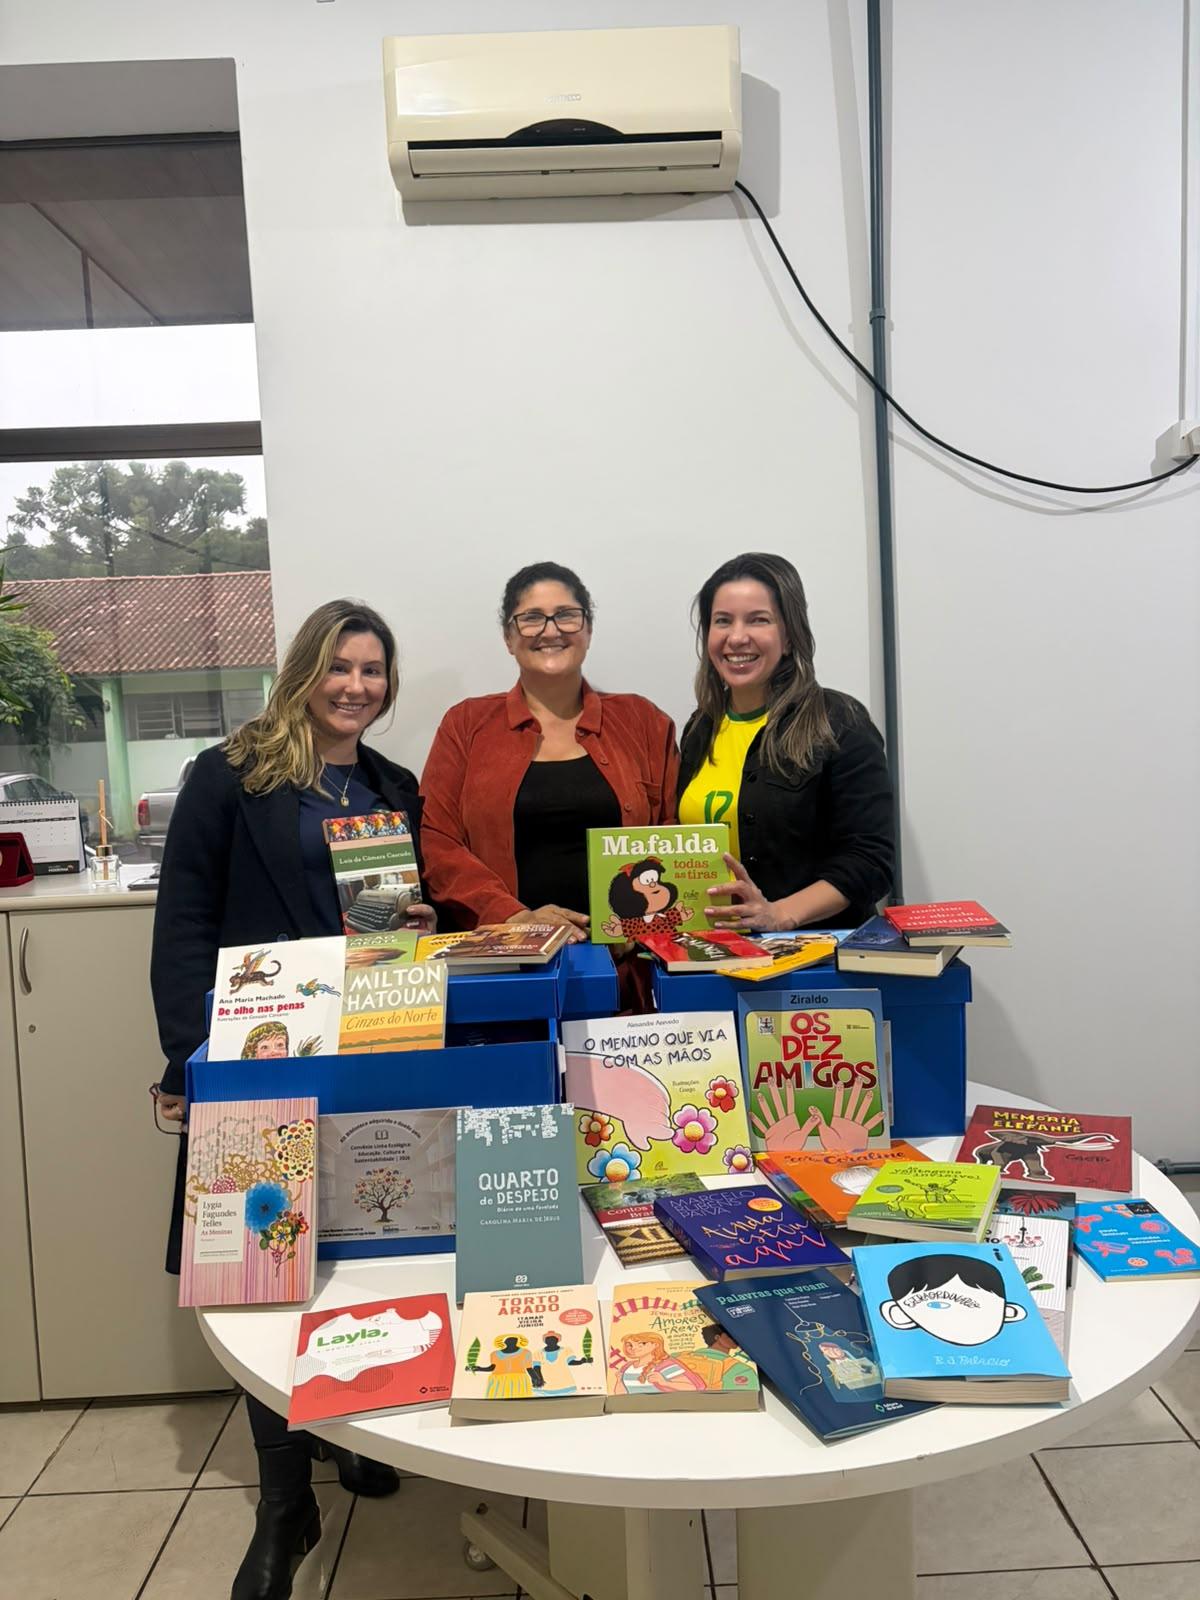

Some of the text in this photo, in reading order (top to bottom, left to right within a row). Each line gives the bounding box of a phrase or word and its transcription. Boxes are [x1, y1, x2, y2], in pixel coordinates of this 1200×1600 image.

[601, 832, 719, 856] Mafalda
[386, 850, 412, 859] Cascudo
[673, 859, 709, 869] todas
[687, 869, 718, 880] tiras
[350, 963, 442, 992] MILTON
[255, 993, 286, 1002] Machado
[348, 987, 441, 1012] HATOUM
[790, 994, 829, 1005] Ziraldo
[217, 1001, 306, 1017] De olho nas penas
[346, 1009, 438, 1031] Cinzas do Norte
[790, 1011, 832, 1035] OS
[584, 1028, 728, 1051] O MENINO QUE VIA
[781, 1034, 844, 1062] DEZ
[602, 1047, 712, 1069] COM AS MÃOS
[752, 1060, 878, 1090] AMIGOS
[992, 1120, 1082, 1133] ELEFANTE
[478, 1167, 559, 1191] QUARTO
[496, 1187, 559, 1205] DESPEJO
[670, 1190, 756, 1207] MARCELO
[673, 1199, 742, 1210] RUBENS
[202, 1200, 222, 1210] Lygia
[607, 1206, 648, 1216] Contos
[678, 1207, 731, 1218] PAIVA
[202, 1209, 238, 1219] Fagundes
[201, 1219, 223, 1228] Telles
[702, 1211, 784, 1239] Ainda
[738, 1219, 809, 1245] estou
[724, 1232, 827, 1266] aqui
[498, 1294, 560, 1307] TORTO
[715, 1289, 773, 1306] Palavras
[772, 1286, 796, 1297] que
[795, 1281, 830, 1294] voam
[497, 1303, 560, 1316] ARADO
[316, 1328, 389, 1347] Layla,
